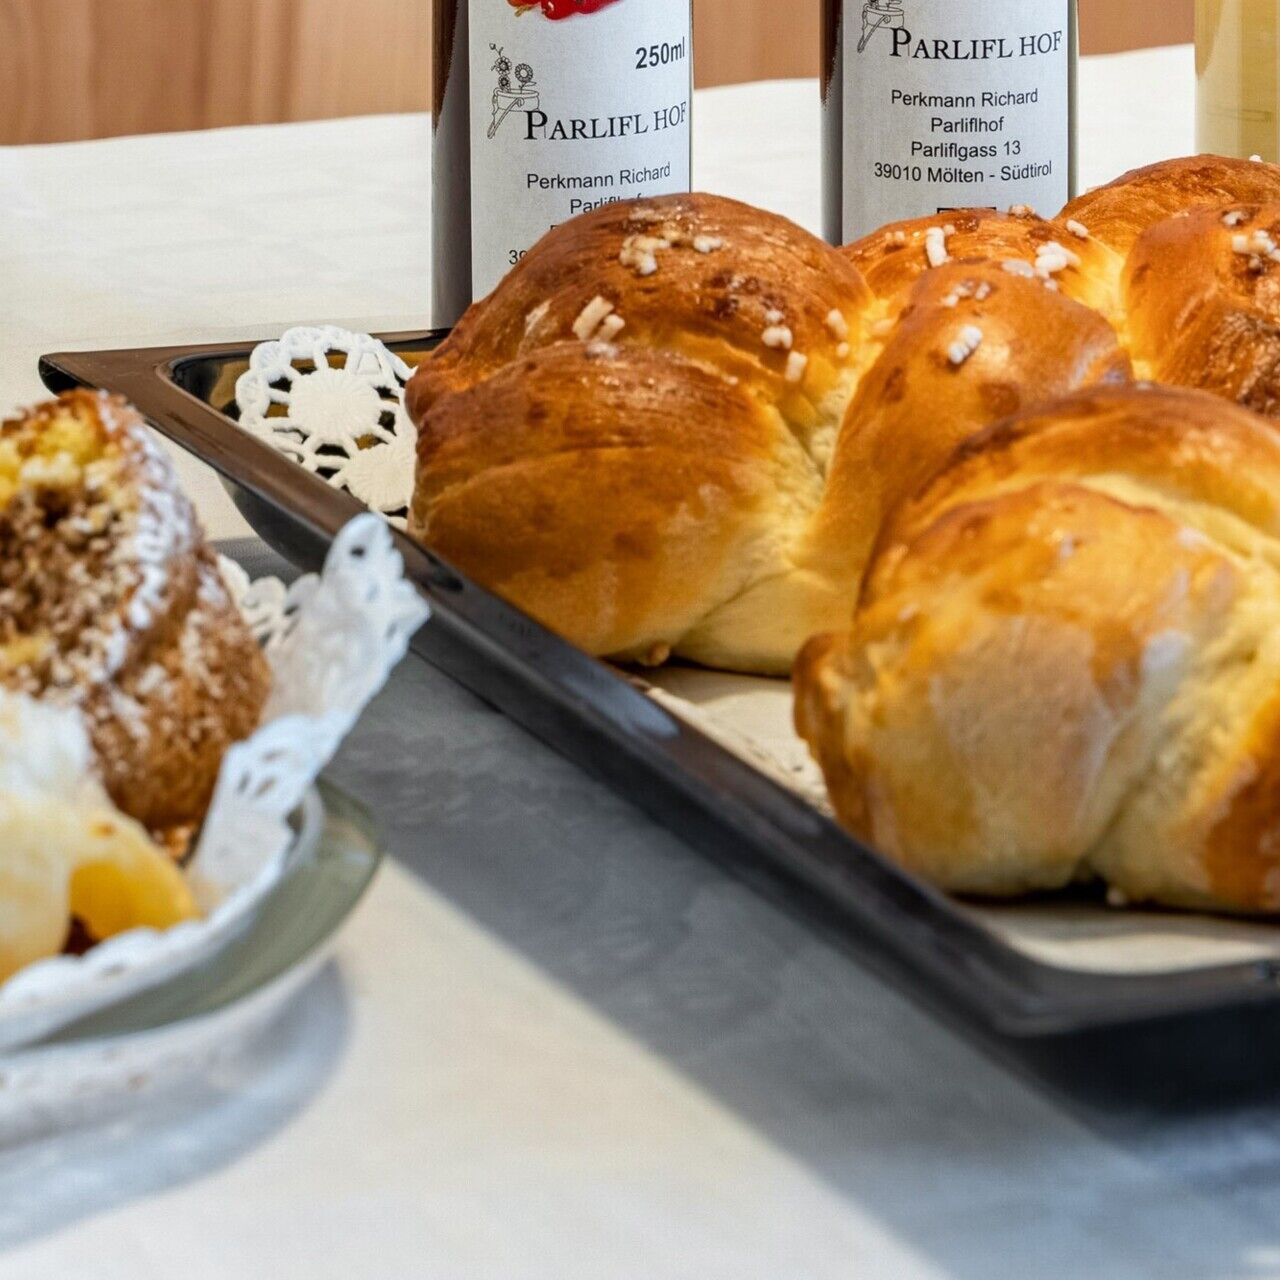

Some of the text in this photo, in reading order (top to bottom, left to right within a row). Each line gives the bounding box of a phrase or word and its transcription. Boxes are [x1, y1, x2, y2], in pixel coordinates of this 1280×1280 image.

[635, 36, 685, 69] 250ml
[1019, 30, 1062, 56] HOF
[891, 88, 1038, 107] Perkmann Richard
[653, 101, 686, 131] HOF
[931, 116, 1004, 133] Parliflhof
[911, 140, 1021, 162] Parliflgass 13
[527, 162, 671, 189] Perkmann Richard
[874, 162, 921, 181] 39010
[927, 167, 984, 183] Mölten
[1000, 160, 1052, 181] Südtirol
